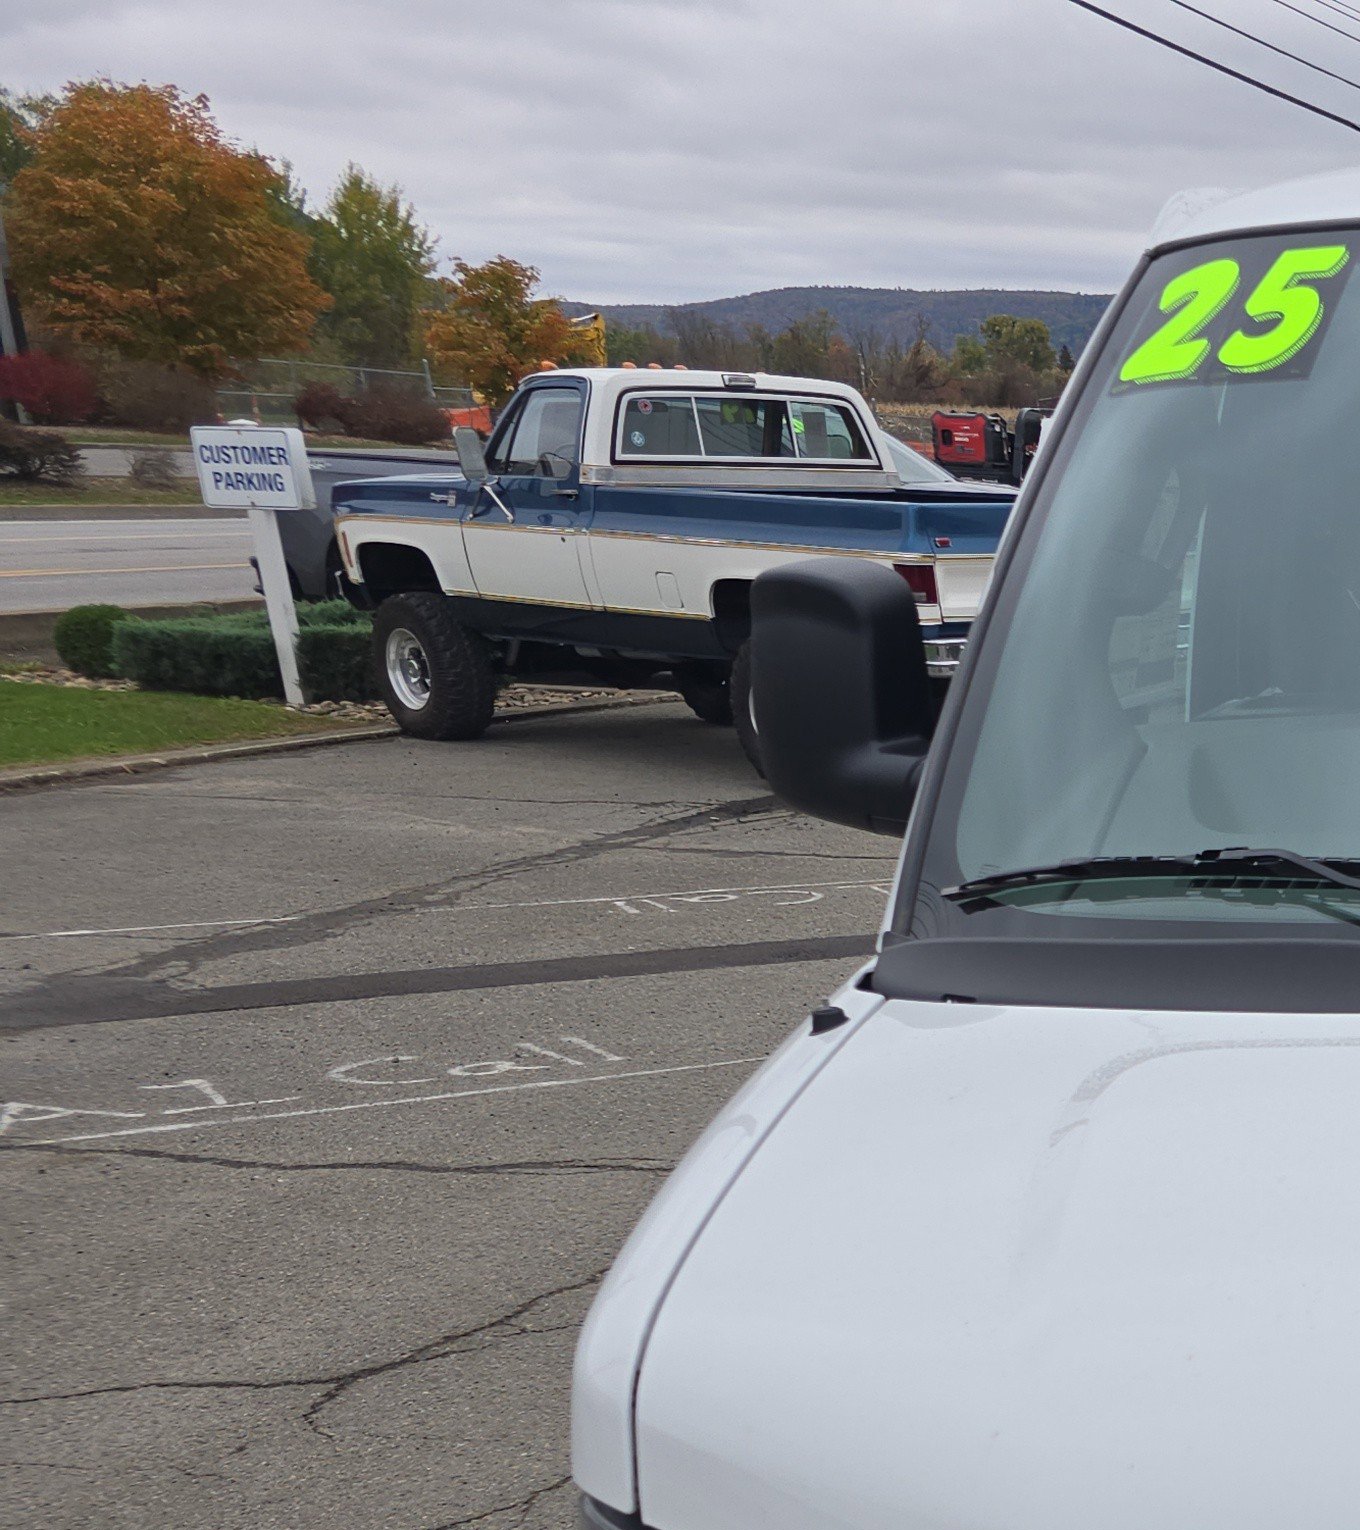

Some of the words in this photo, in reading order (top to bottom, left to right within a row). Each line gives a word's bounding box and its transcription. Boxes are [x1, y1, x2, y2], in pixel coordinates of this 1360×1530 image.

[1119, 245, 1350, 384] 25
[199, 444, 289, 465] CUSTOMER
[212, 471, 285, 492] PARKING
[327, 1036, 628, 1085] Call
